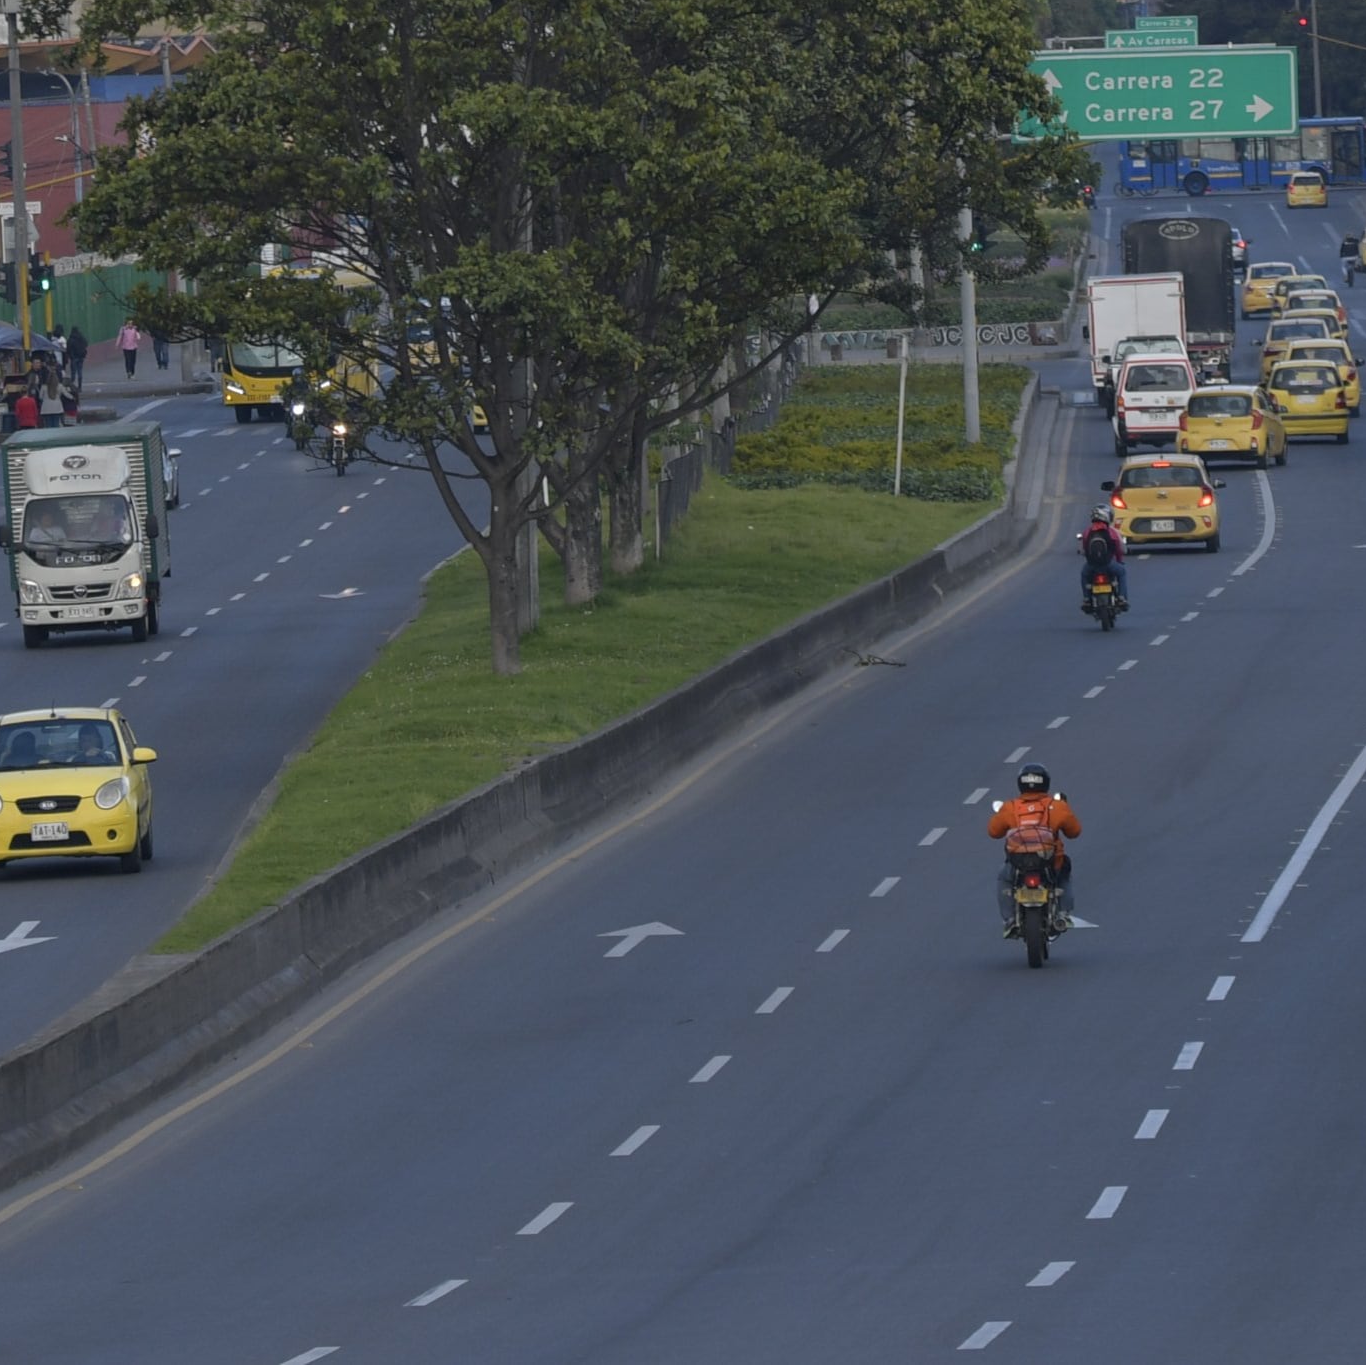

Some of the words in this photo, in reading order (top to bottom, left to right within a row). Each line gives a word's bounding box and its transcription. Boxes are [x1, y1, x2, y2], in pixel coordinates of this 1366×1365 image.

[1129, 37, 1143, 46] Av
[1146, 36, 1188, 46] Caracas
[1086, 72, 1173, 90] Carrera
[1189, 69, 1224, 88] 22
[1086, 104, 1173, 122] Carrera
[1189, 100, 1224, 120] 27
